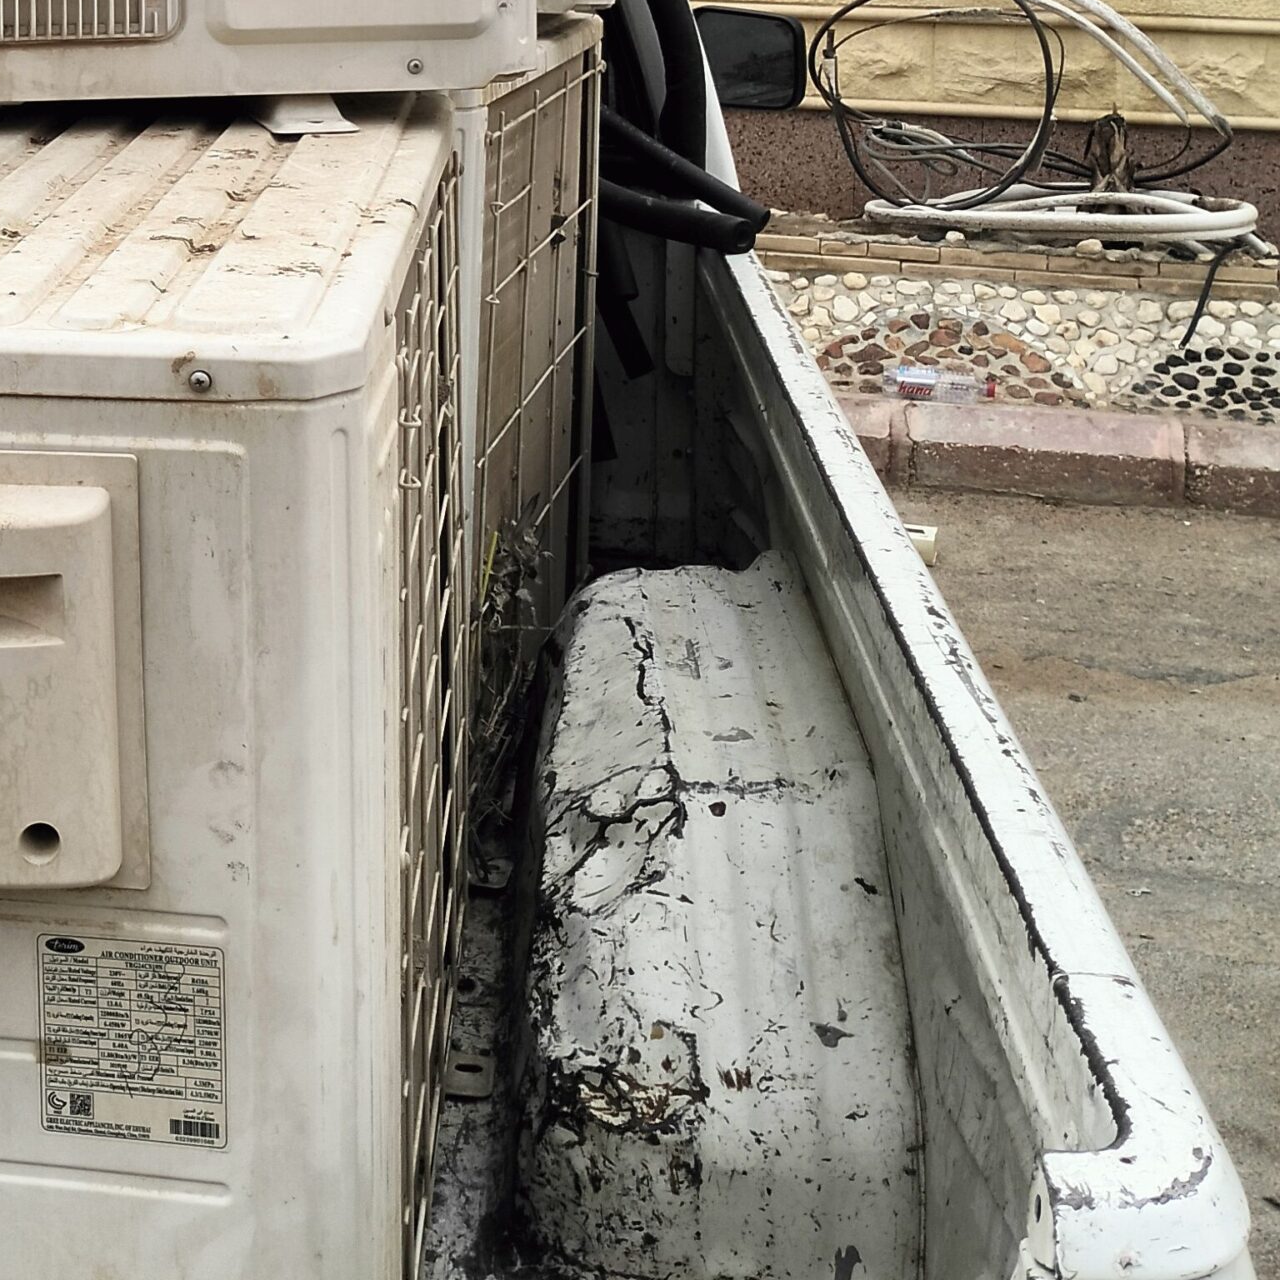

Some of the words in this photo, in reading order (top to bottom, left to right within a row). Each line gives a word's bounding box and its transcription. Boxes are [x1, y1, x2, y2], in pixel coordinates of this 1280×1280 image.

[114, 951, 163, 962] CONDITIONER
[164, 955, 199, 965] OUTDOOR
[200, 958, 218, 966] UNIT
